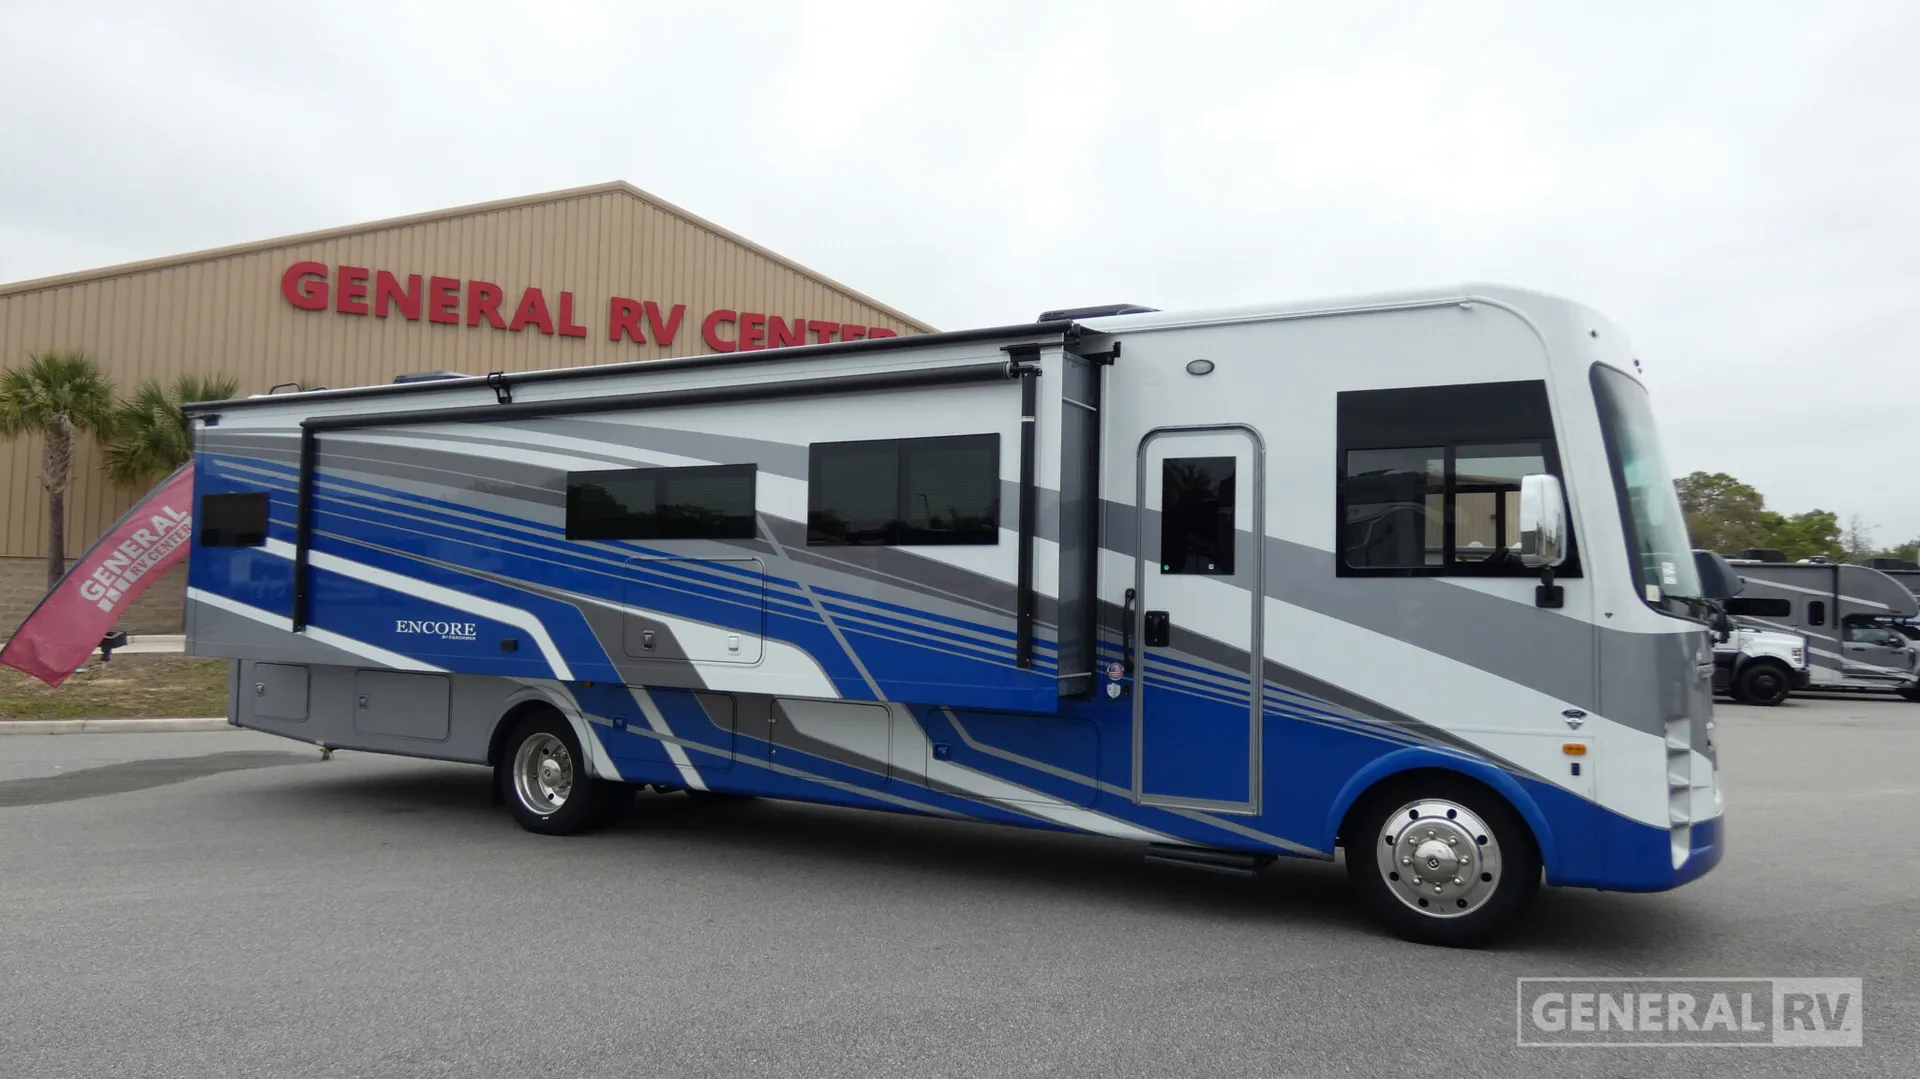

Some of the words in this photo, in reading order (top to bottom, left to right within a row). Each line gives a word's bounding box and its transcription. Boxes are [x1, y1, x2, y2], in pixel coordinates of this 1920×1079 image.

[281, 261, 587, 338] GENERAL
[609, 296, 686, 346] RV
[701, 309, 898, 352] CENT
[80, 505, 188, 601] GENERAL
[131, 558, 148, 576] RV
[395, 619, 477, 636] ENCORE
